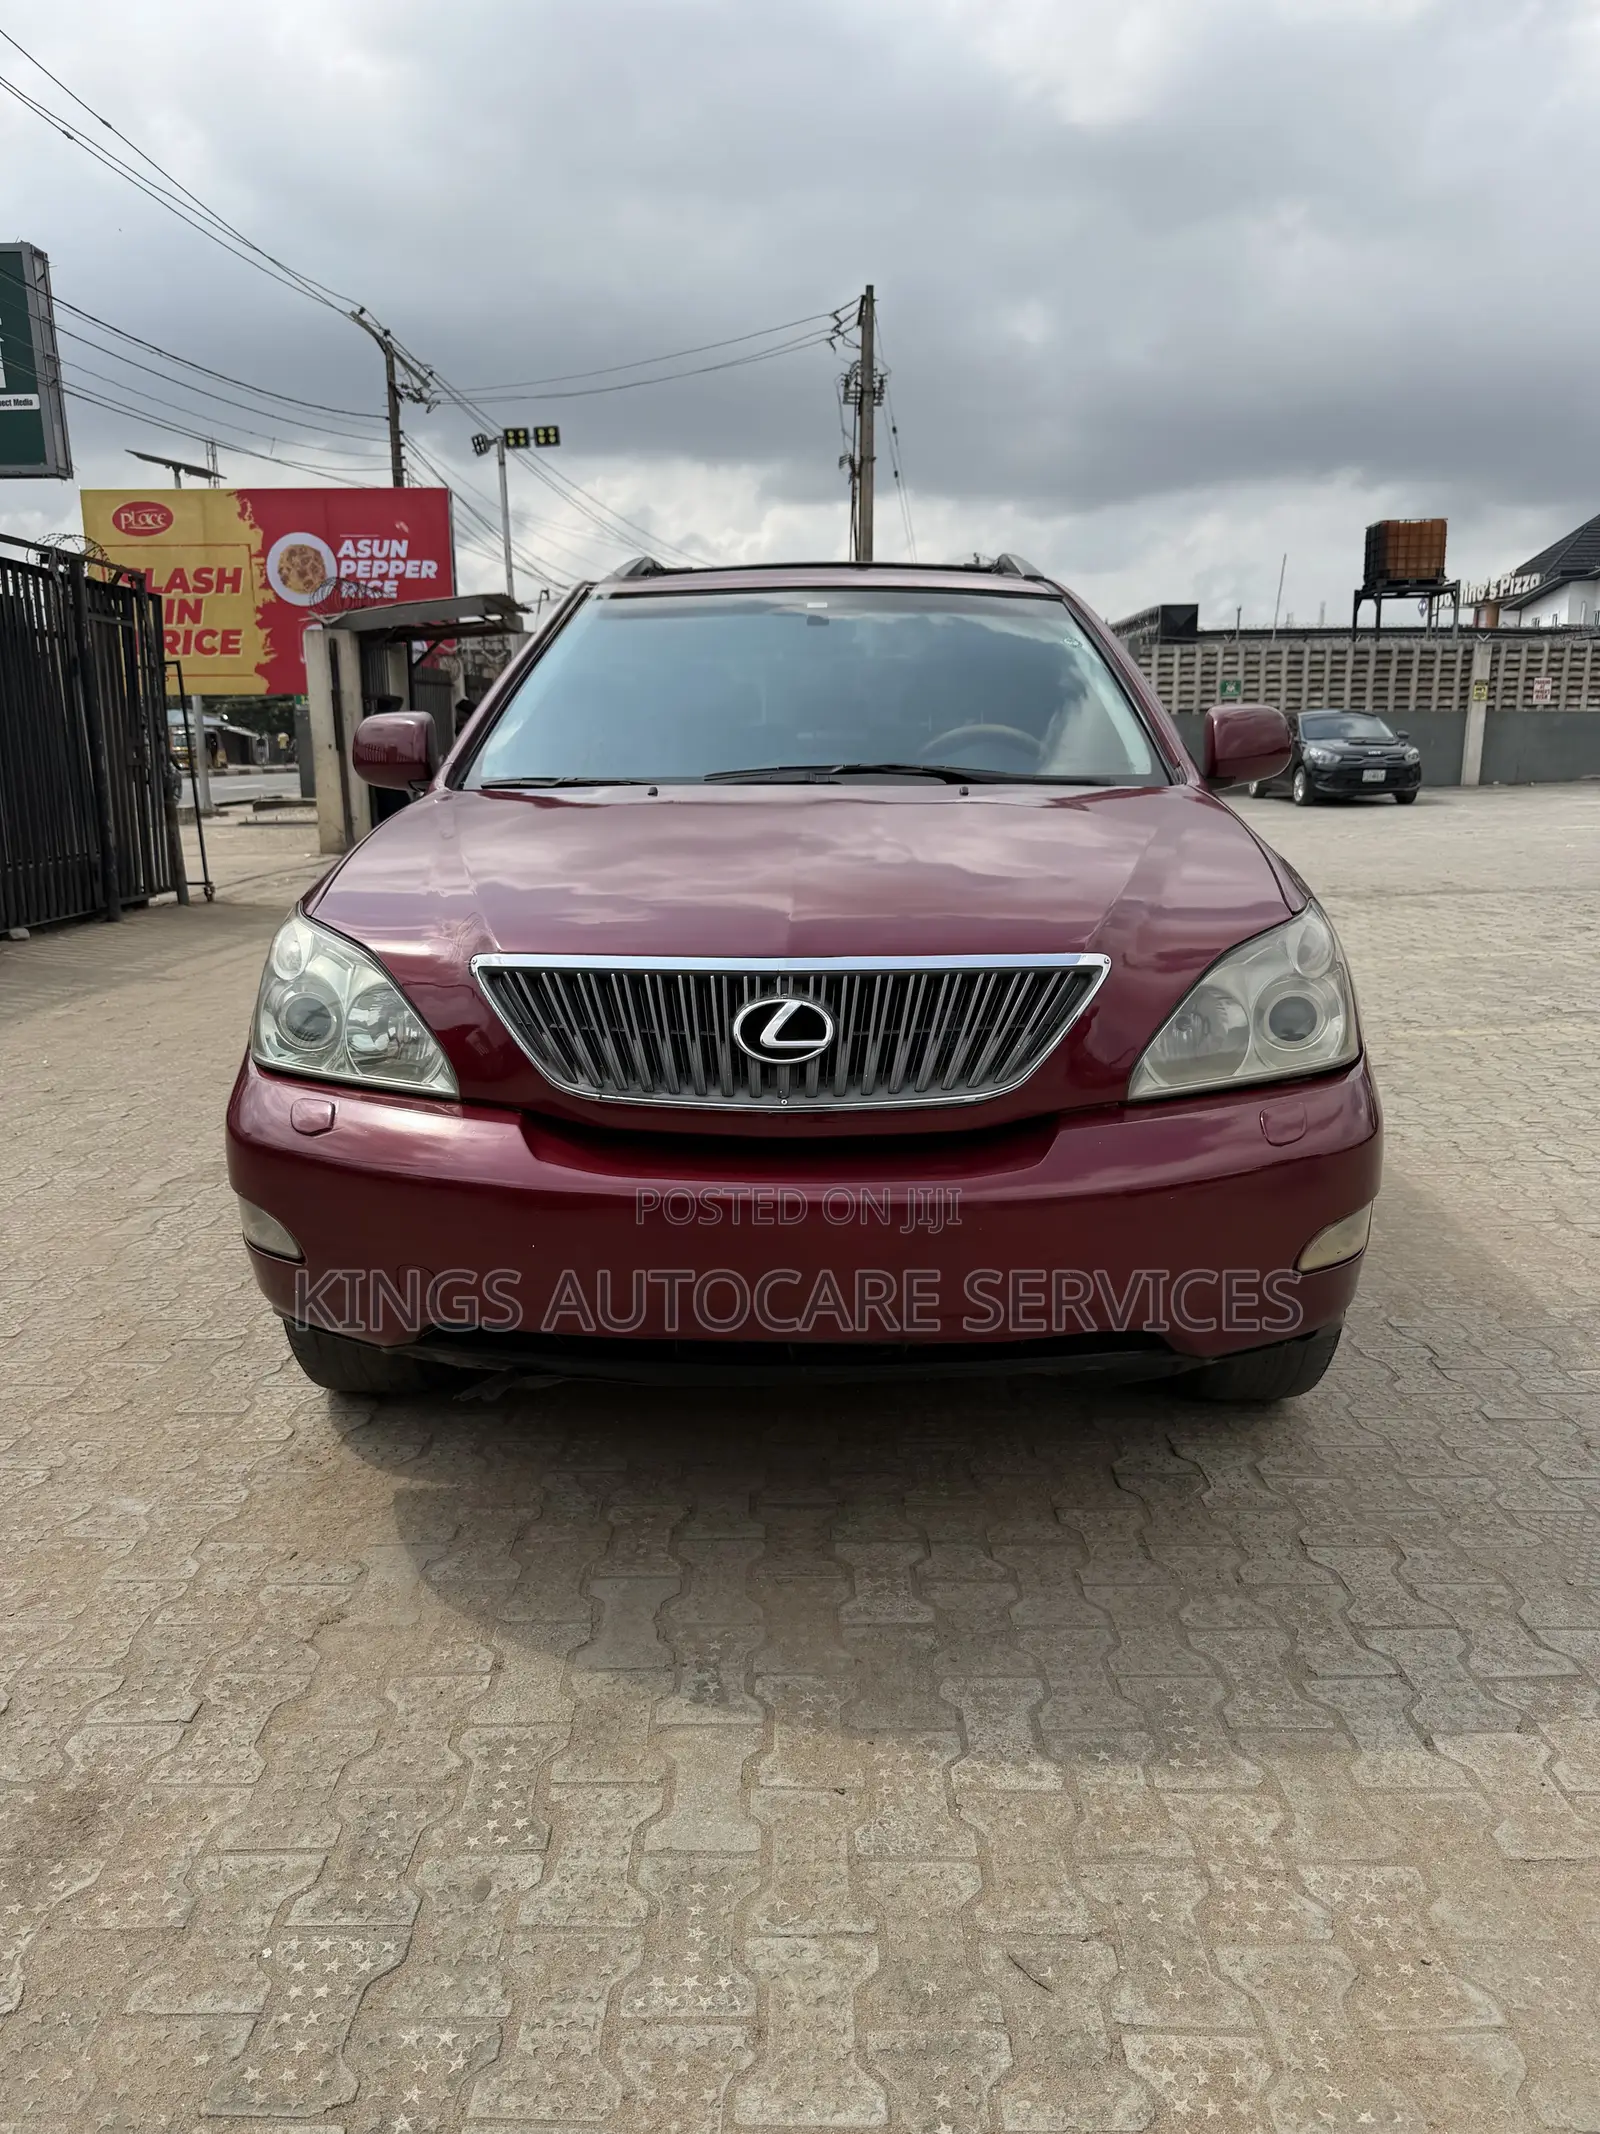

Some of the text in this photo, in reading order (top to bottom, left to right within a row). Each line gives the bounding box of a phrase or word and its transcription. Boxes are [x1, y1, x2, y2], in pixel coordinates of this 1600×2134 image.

[13, 398, 33, 406] Media
[337, 539, 409, 559] ASUN
[340, 560, 438, 579] PEPPER
[341, 580, 399, 599] RICE
[1500, 569, 1541, 598] Pizza
[164, 598, 204, 625] IN
[163, 629, 243, 655] RICE
